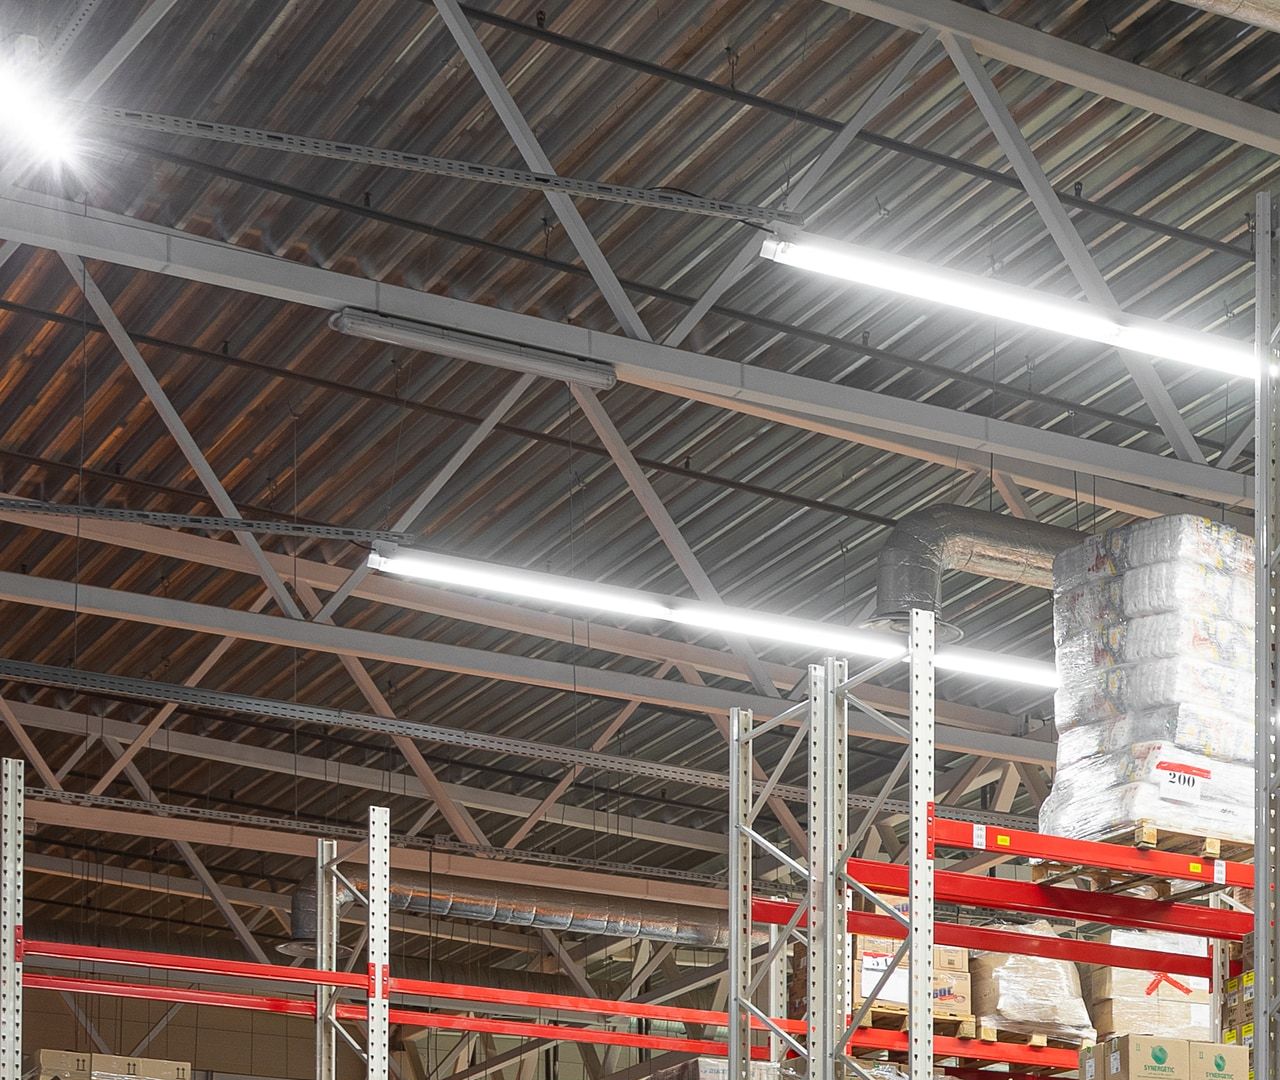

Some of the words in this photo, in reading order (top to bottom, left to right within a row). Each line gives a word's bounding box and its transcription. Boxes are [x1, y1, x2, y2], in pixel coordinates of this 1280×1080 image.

[1168, 771, 1196, 787] 200
[1144, 1064, 1175, 1073] SYNERGETIC
[1205, 1071, 1234, 1080] SYNERGETIC
